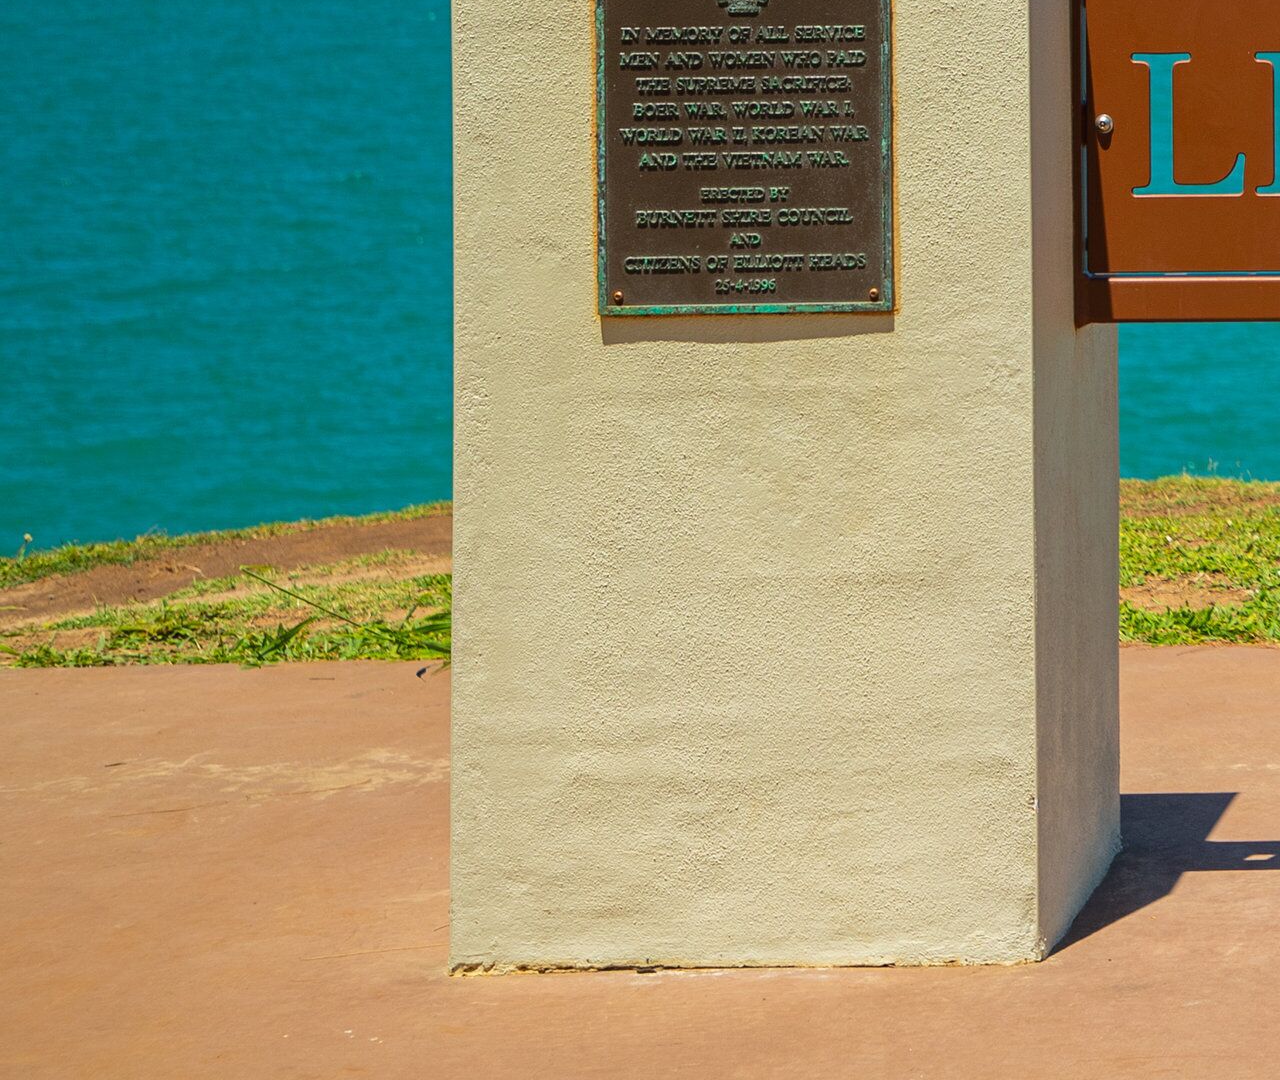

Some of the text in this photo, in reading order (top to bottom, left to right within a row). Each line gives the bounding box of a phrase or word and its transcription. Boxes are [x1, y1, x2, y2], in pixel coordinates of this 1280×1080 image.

[621, 25, 865, 44] IN MEMORY OF ALL SERVICE
[620, 50, 867, 68] MEN AND WOMEN WHO PAID
[636, 77, 671, 94] THE
[677, 77, 755, 94] SUPREME
[633, 102, 679, 119] BOER
[732, 101, 794, 118] WORLD
[800, 101, 839, 117] WAR
[619, 128, 683, 144] WORLD
[688, 128, 727, 143] WAR
[752, 126, 824, 142] KOREAN
[830, 126, 868, 142] WAR
[639, 153, 677, 169] AND
[683, 153, 717, 168] THE
[723, 152, 801, 168] VIETNAM
[701, 187, 789, 202] ERECTED BY
[636, 208, 853, 227] BURNETT SHIRE COUNCIL
[730, 234, 761, 248] AND
[624, 254, 867, 274] CITIZENS OF ELLIOTT HEADS
